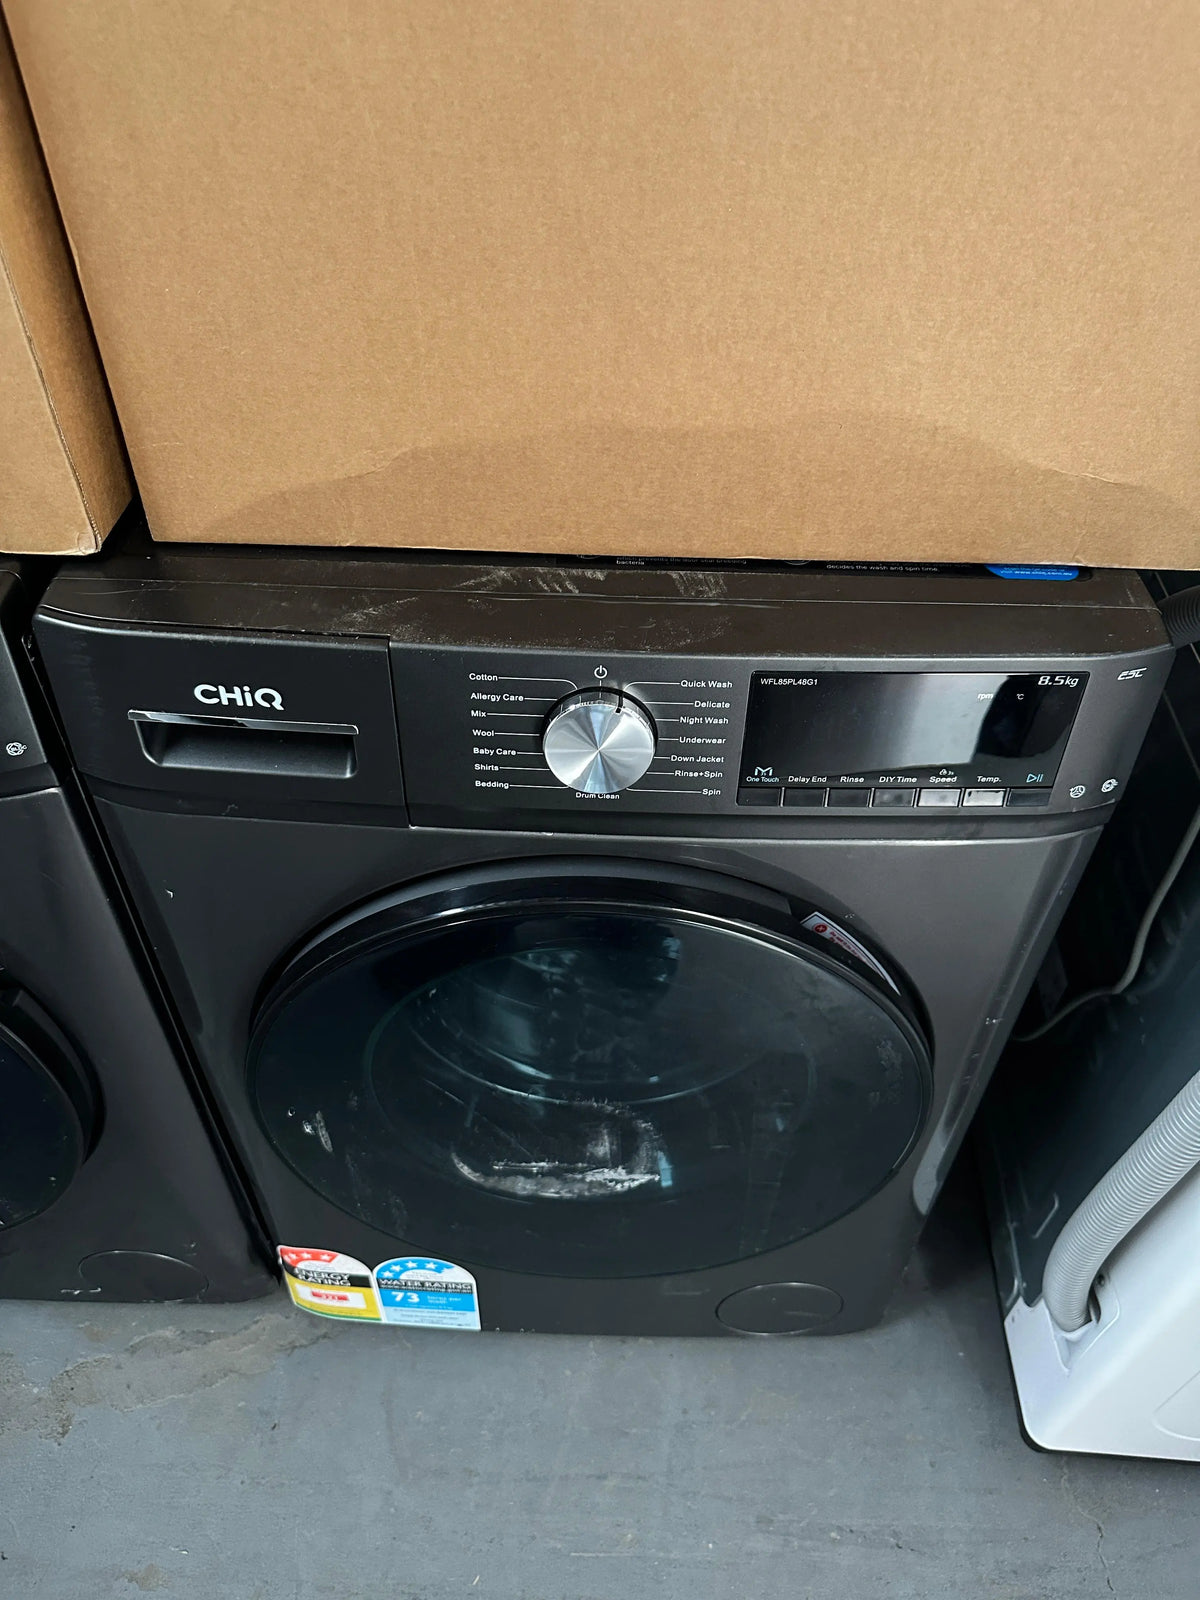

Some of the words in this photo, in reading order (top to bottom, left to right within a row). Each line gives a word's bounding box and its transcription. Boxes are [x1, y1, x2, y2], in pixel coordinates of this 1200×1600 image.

[469, 673, 498, 682] Cotton
[1037, 675, 1079, 687] 8.5kg
[680, 680, 706, 689] Quick
[760, 678, 818, 686] WFL85PL48G1
[193, 683, 285, 711] CHiQ
[470, 693, 501, 703] Allergy
[977, 693, 993, 701] rpm
[680, 717, 704, 725] Night
[473, 748, 495, 756] Baby
[697, 755, 724, 763] Jacket
[674, 770, 723, 778] Rinse+Spin
[929, 776, 957, 784] Speed
[475, 781, 509, 789] Bedding
[702, 788, 721, 796] Spin
[294, 1268, 350, 1280] ENERGY
[298, 1275, 351, 1286] RATING
[379, 1279, 422, 1288] WATER
[424, 1281, 471, 1290] RATING
[391, 1292, 420, 1303] 73
